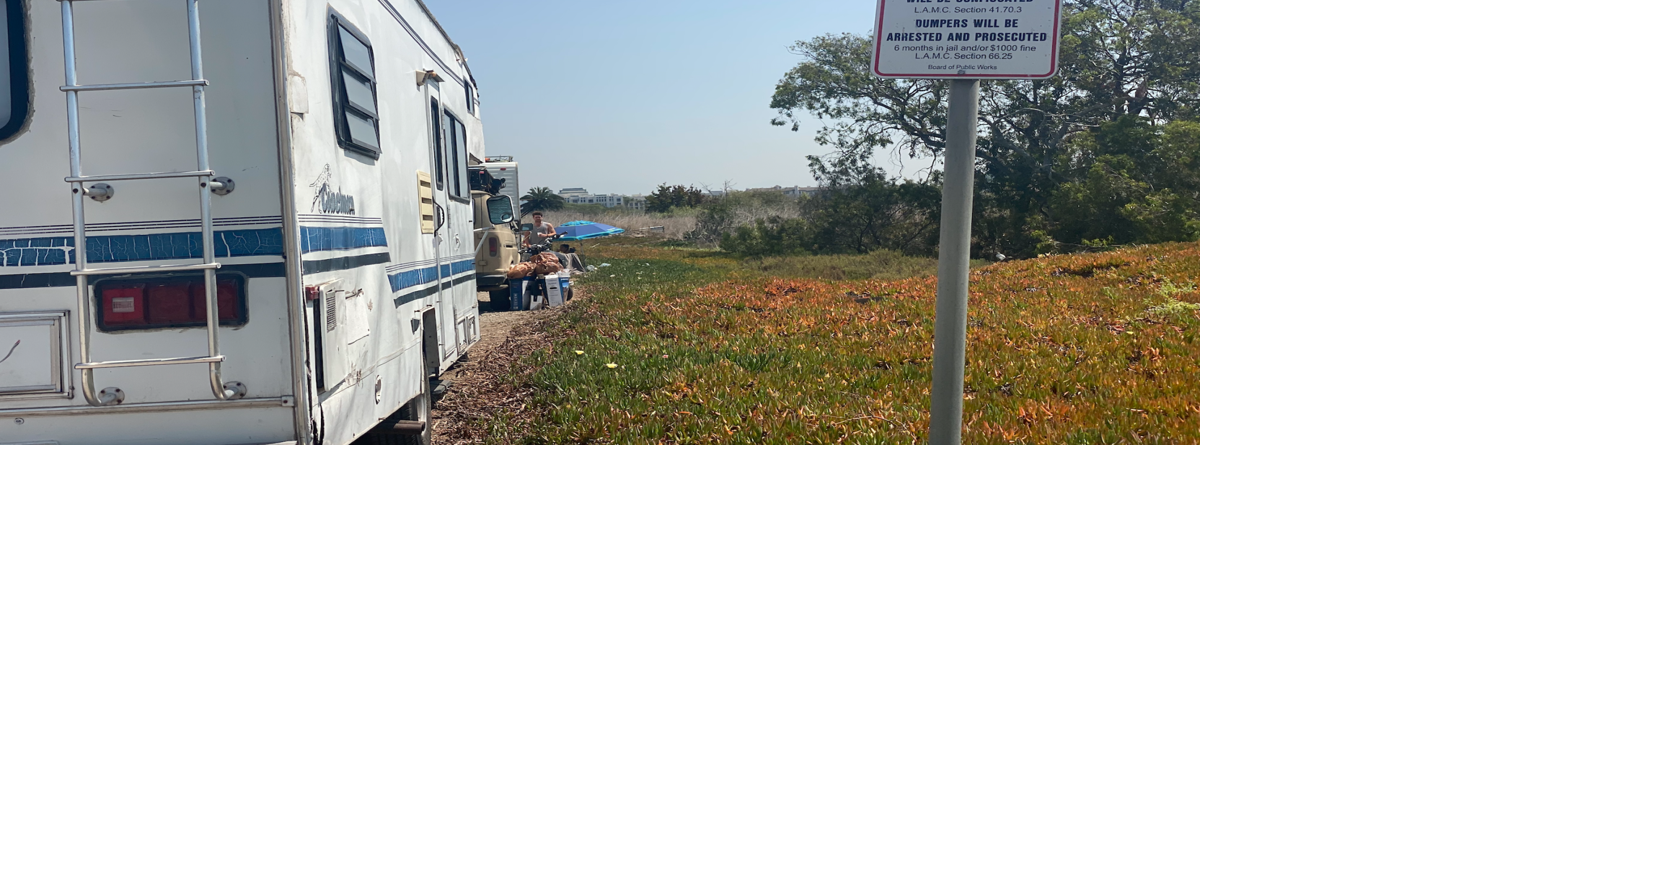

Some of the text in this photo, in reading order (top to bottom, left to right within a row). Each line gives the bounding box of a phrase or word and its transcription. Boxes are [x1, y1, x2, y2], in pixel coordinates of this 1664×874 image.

[915, 19, 1018, 28] DUMPERS WILL BE
[886, 32, 1047, 42] ARRESTED AND PROSECUTED
[946, 45, 959, 53] jail
